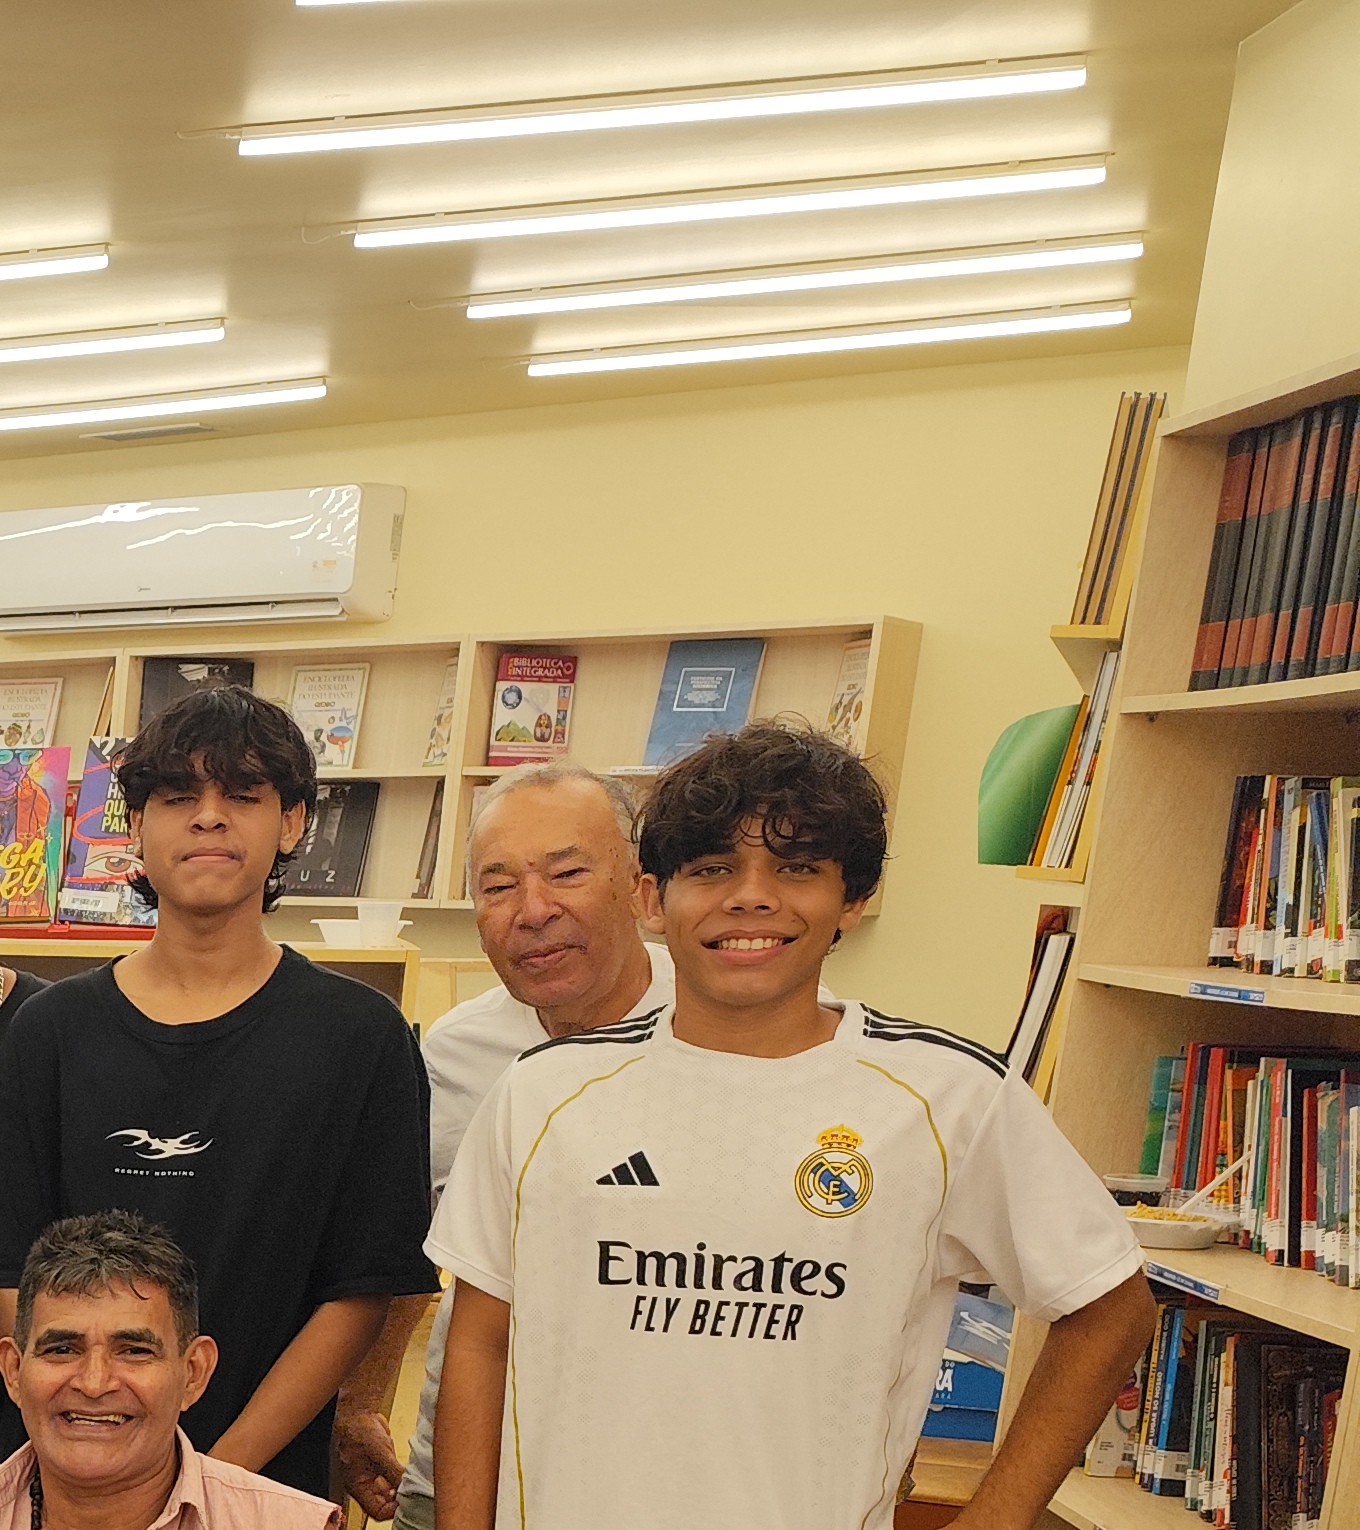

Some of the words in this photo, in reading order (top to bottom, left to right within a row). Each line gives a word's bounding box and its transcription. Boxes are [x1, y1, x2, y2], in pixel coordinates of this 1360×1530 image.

[514, 657, 564, 668] BIBLIOTECA
[512, 667, 563, 677] INTEGRADA
[114, 1167, 151, 1176] REGRET
[596, 1240, 848, 1300] Emirates
[630, 1295, 681, 1334] FLY
[688, 1298, 805, 1342] BETTER
